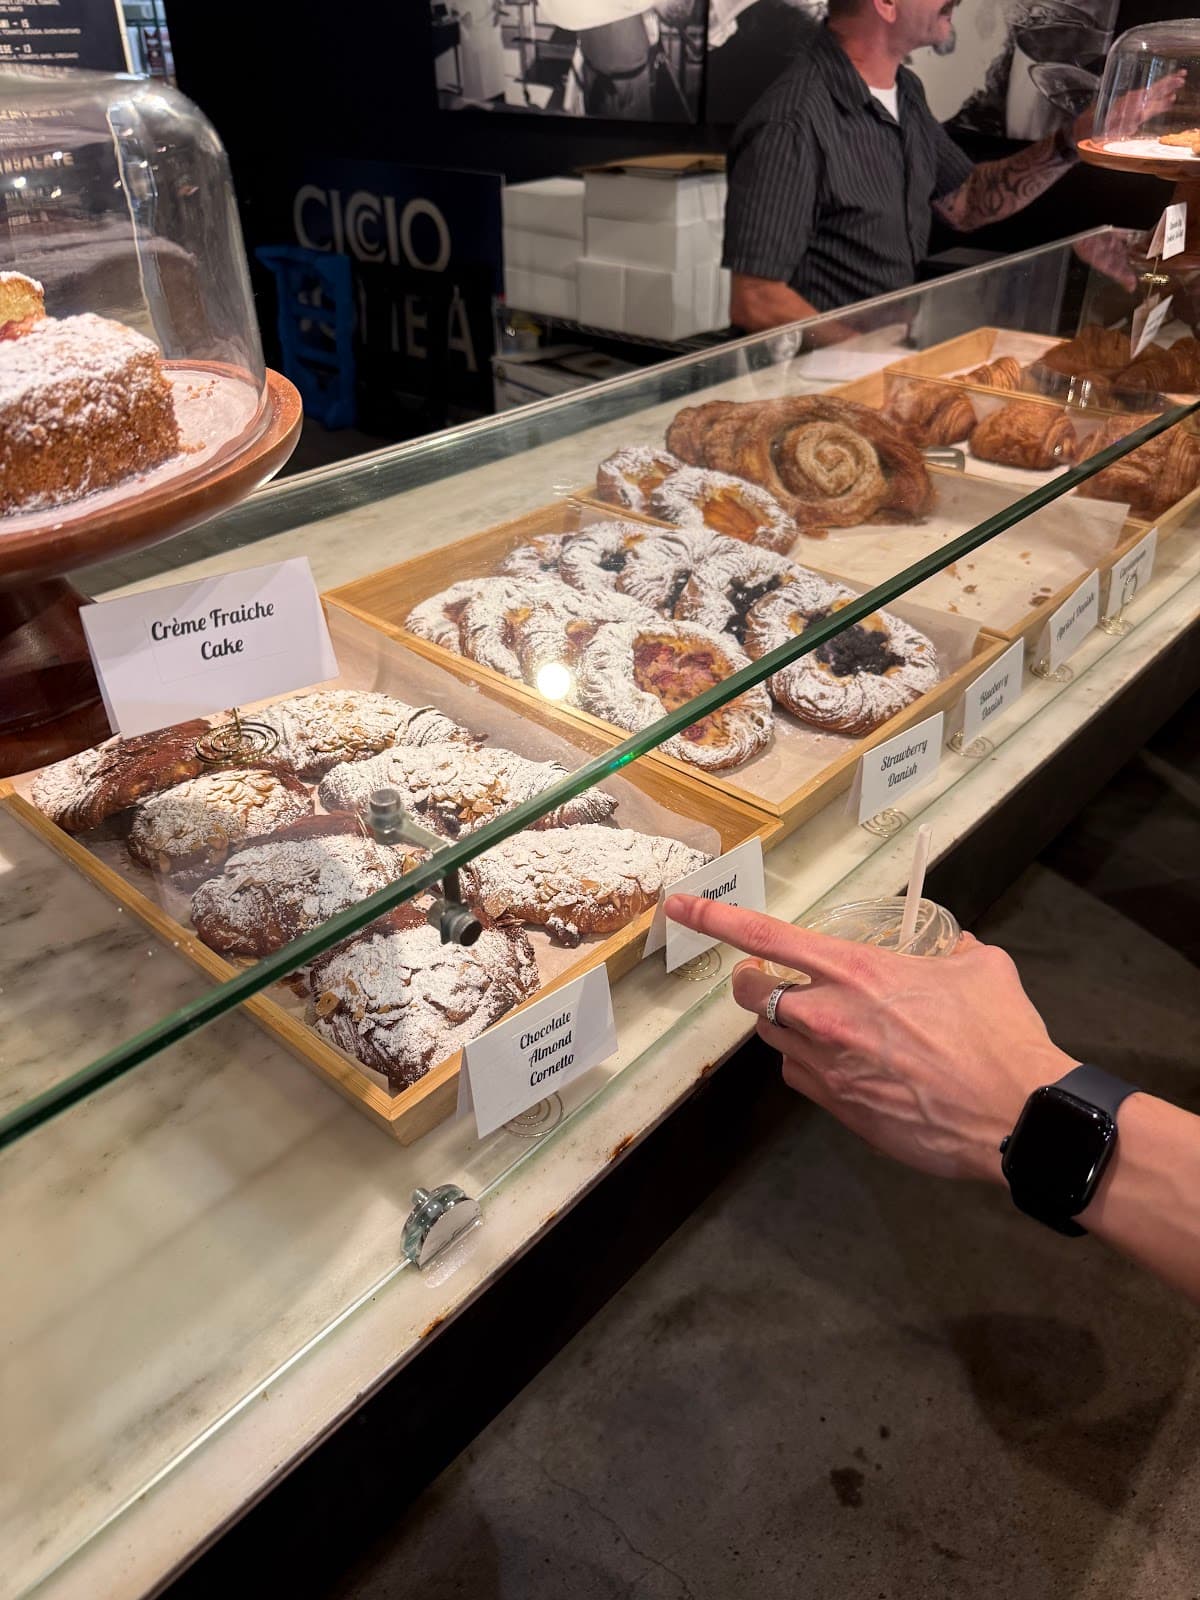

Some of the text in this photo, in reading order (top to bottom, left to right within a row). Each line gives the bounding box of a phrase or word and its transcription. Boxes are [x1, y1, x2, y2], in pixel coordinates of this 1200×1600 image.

[151, 601, 275, 641] Crème Fraiche
[201, 638, 244, 660] Cake
[880, 739, 928, 771] Strawberry
[887, 762, 918, 787] Danish
[519, 1012, 571, 1050] Chocolate
[529, 1030, 572, 1067] Almond
[530, 1054, 575, 1087] Cornetto
